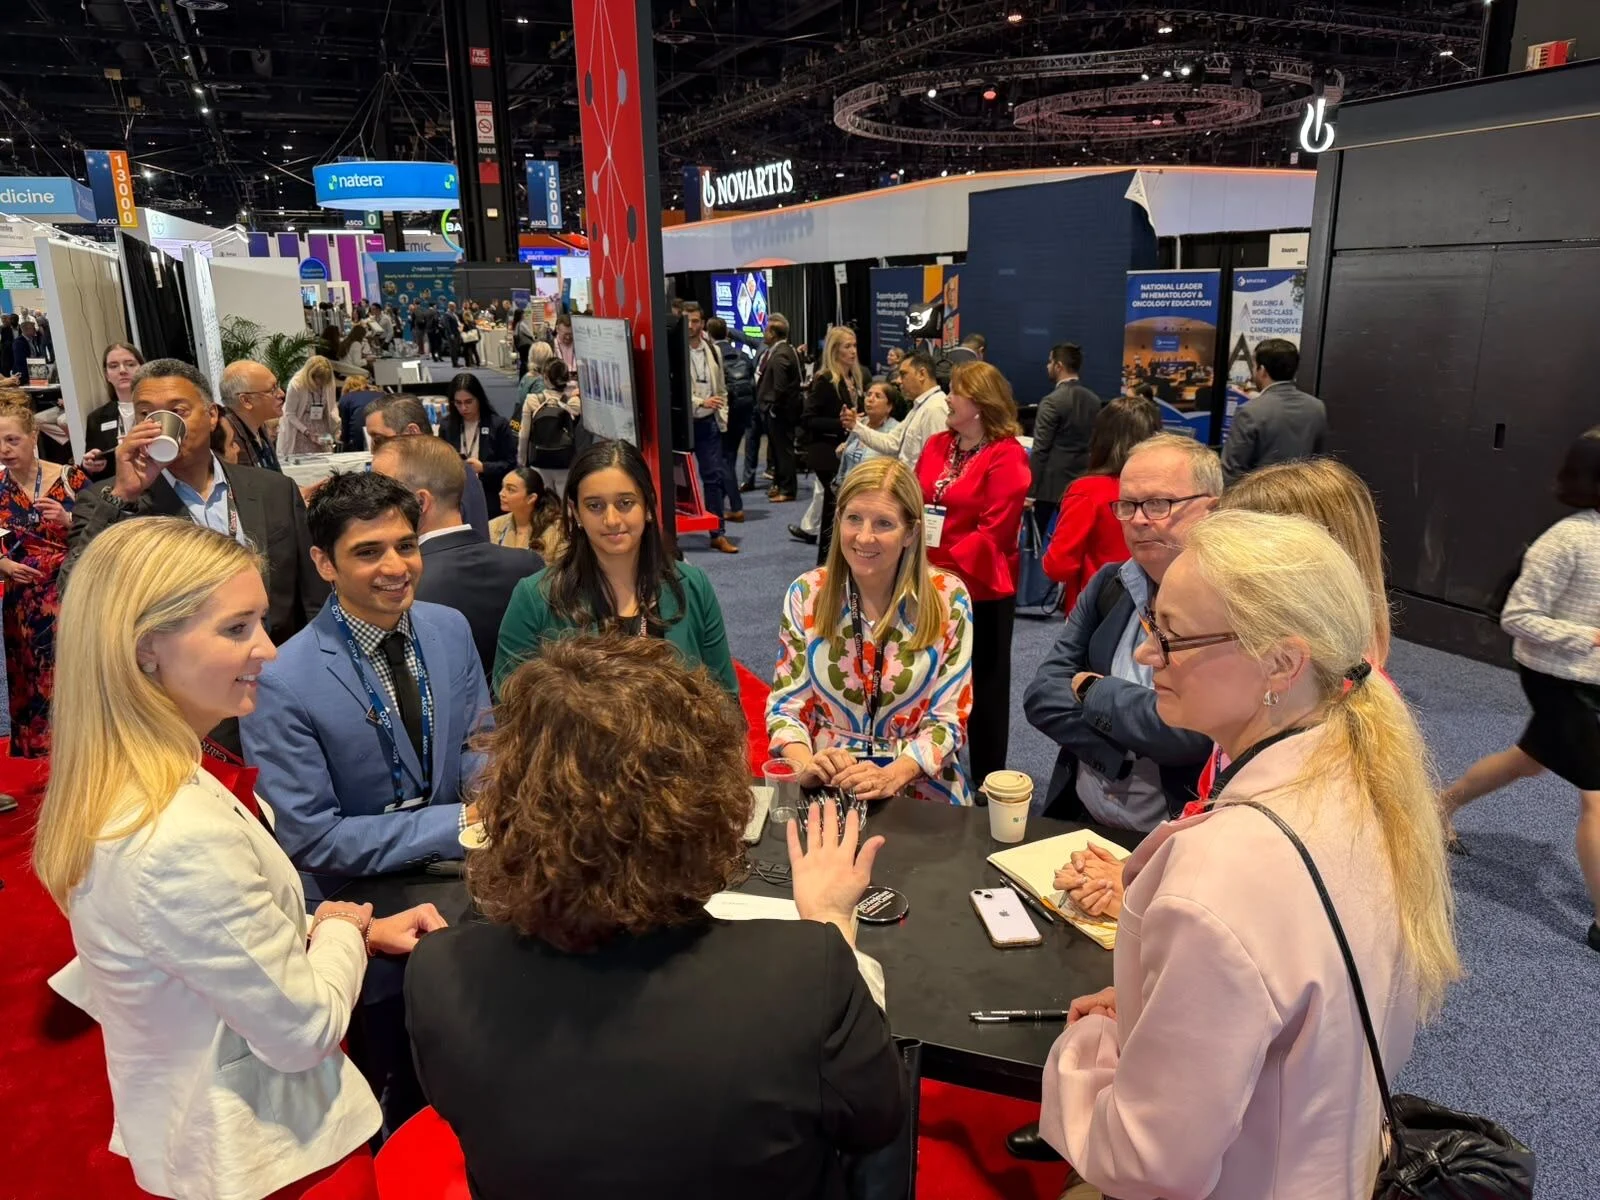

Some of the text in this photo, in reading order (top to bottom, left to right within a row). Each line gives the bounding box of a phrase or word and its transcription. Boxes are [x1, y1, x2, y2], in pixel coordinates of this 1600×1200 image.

[338, 173, 384, 188] natera
[716, 159, 794, 205] NOVARTIS
[0, 189, 55, 204] dicine
[114, 155, 133, 224] 13000
[548, 164, 560, 226] 15000
[1140, 282, 1204, 291] NATIONAL LEADER
[1149, 291, 1197, 299] HEMATOLOGY
[1131, 300, 1171, 308] ONCOLOGY
[1251, 308, 1293, 316] WORLD-CLASS
[331, 605, 343, 622] ASCO
[347, 639, 359, 658] ASCO
[380, 710, 392, 729] ASCO
